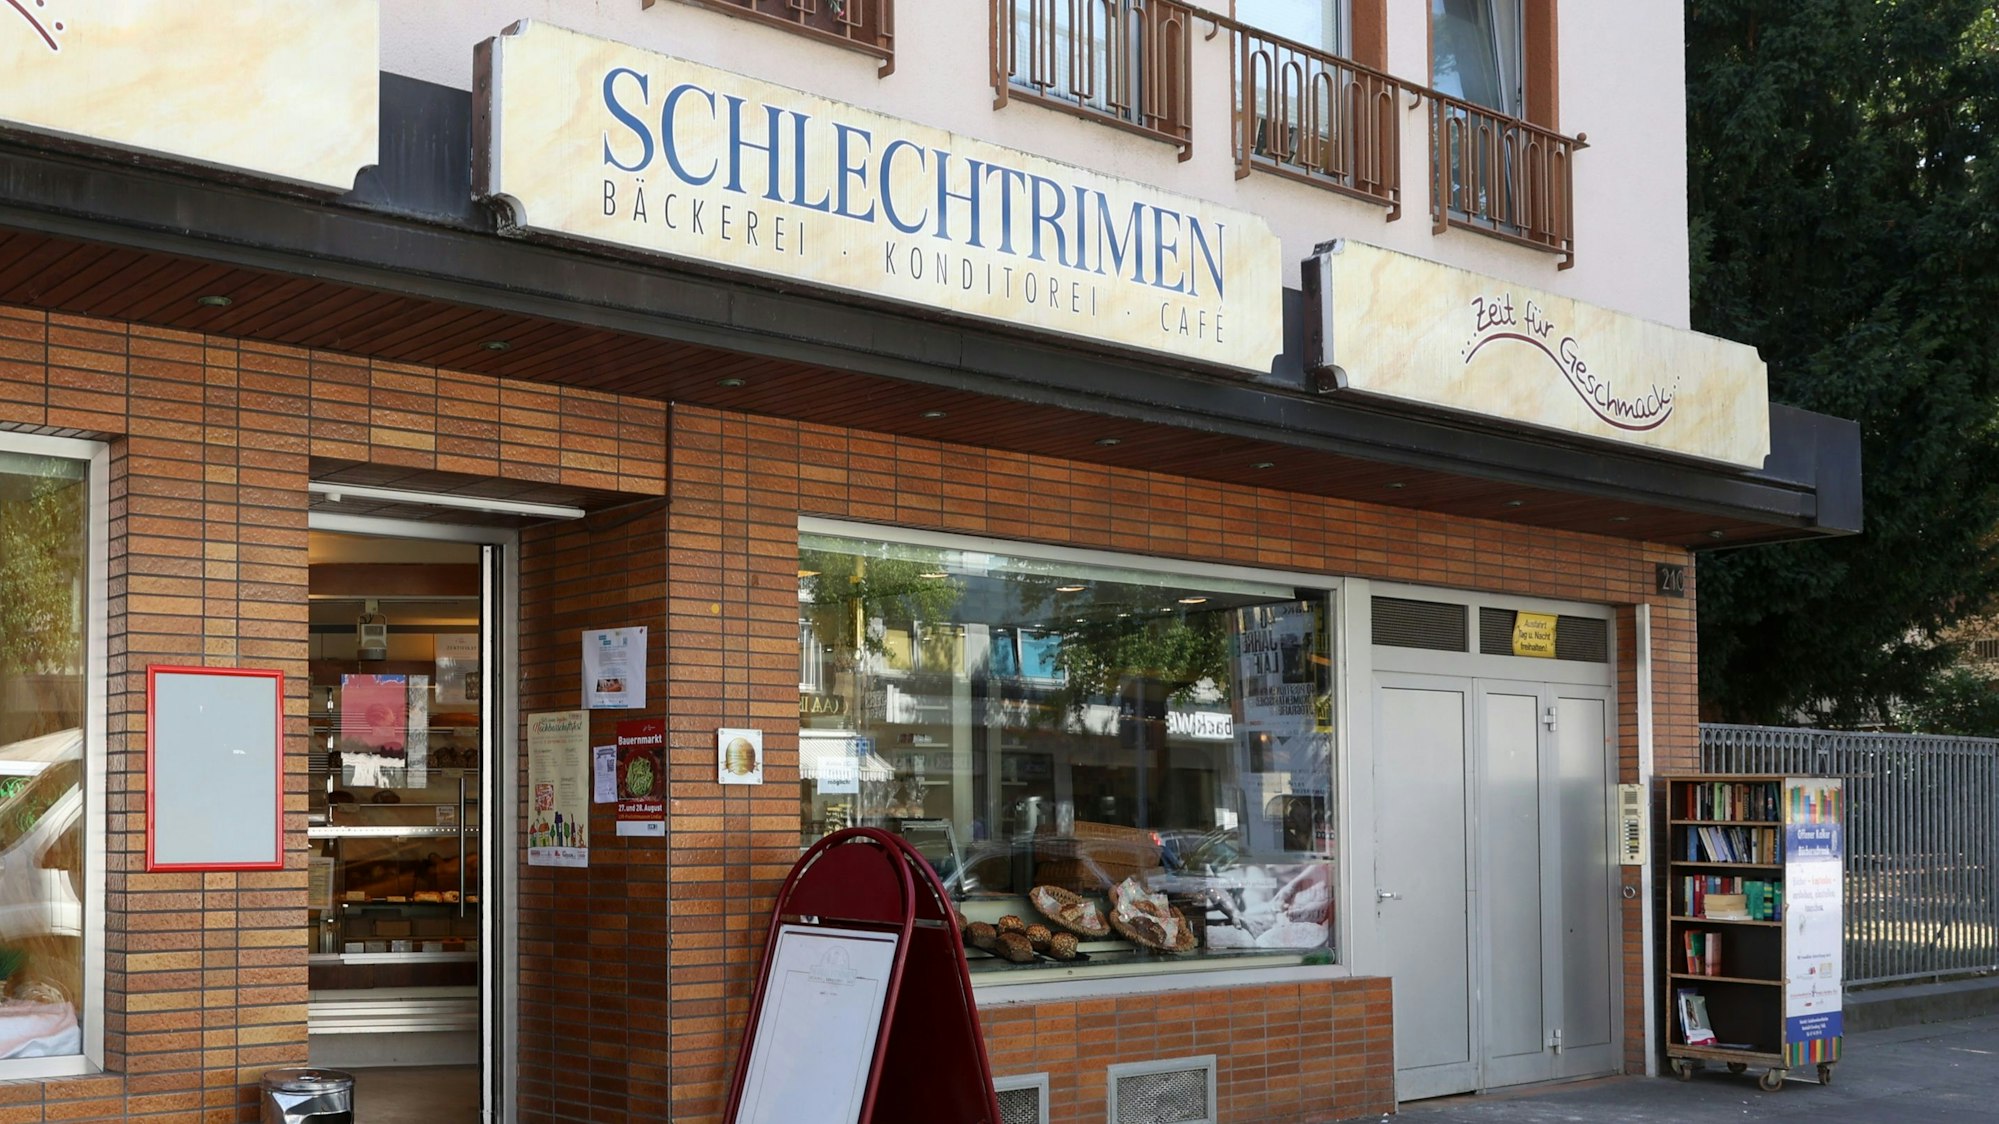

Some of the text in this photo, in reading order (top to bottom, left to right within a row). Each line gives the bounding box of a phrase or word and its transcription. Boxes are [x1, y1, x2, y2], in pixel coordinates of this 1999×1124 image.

[602, 67, 1226, 303] SCHLECHTRIMEN
[602, 180, 1226, 345] BÄCKEREI KONDITOREI CAFÉ
[1471, 293, 1517, 333] Zeit
[1524, 301, 1554, 339] für
[1662, 568, 1685, 592] 210
[1524, 619, 1547, 630] Ausfahrt
[1519, 628, 1528, 641] Tag
[1535, 631, 1551, 641] Nacht
[618, 733, 663, 746] Bauernmarkt
[618, 803, 626, 812] 27.
[626, 804, 636, 812] und
[644, 803, 663, 814] August
